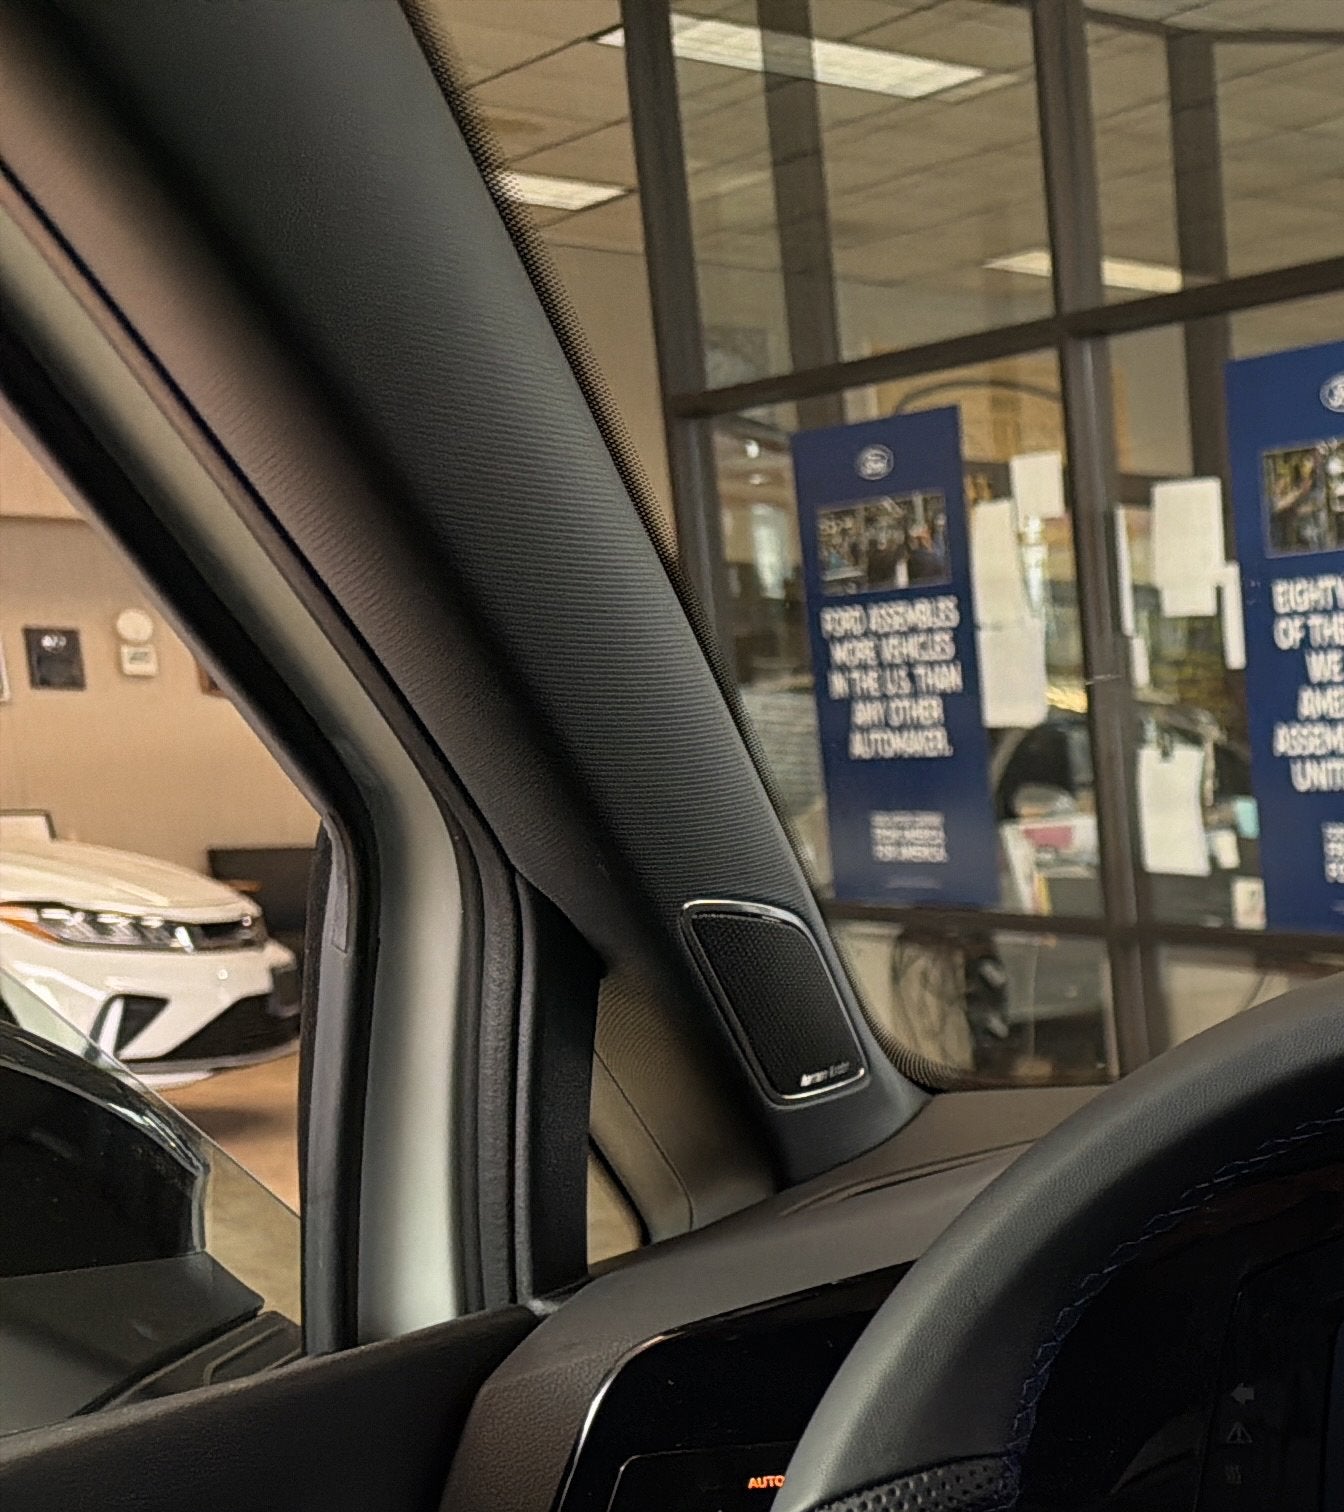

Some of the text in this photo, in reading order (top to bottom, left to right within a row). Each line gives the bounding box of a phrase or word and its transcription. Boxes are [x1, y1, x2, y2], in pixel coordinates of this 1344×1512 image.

[1273, 615, 1305, 650] OF
[1305, 648, 1344, 684] WE
[748, 1475, 786, 1490] AUTO
